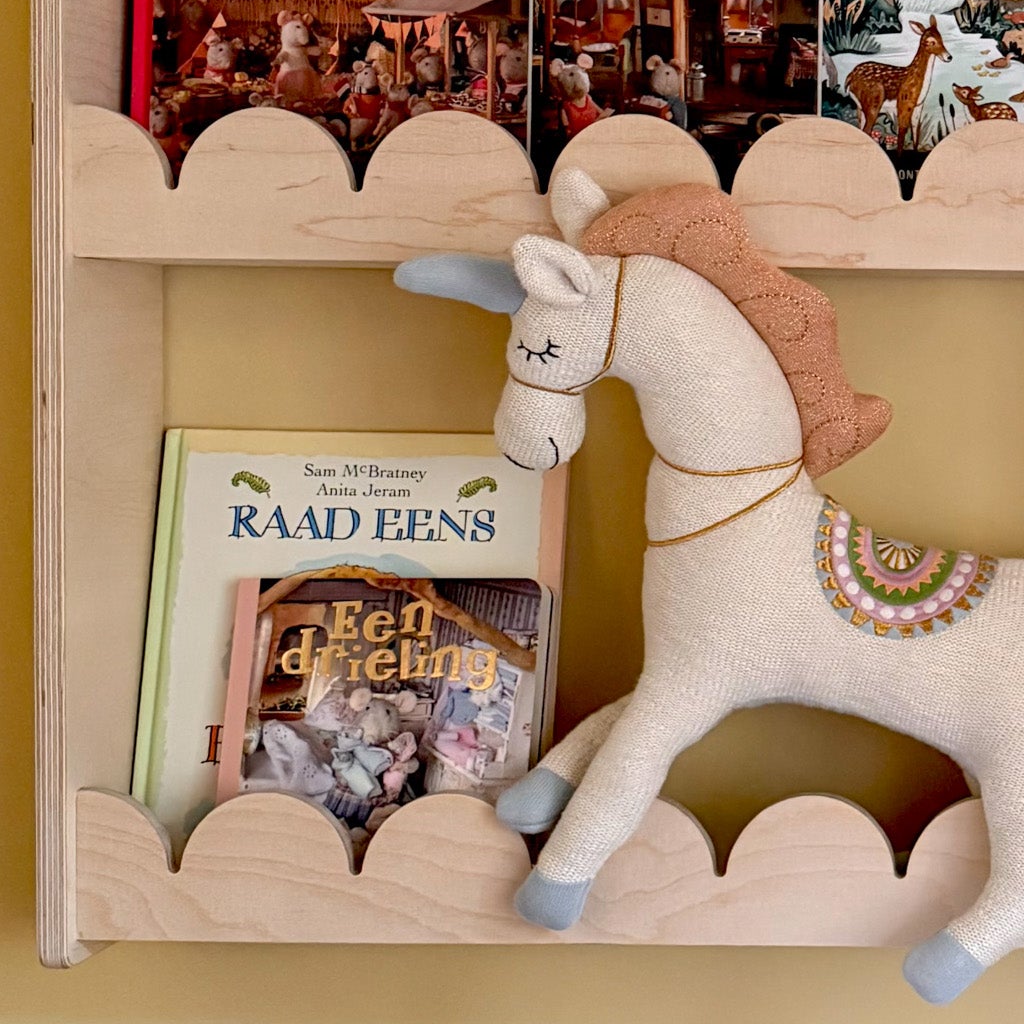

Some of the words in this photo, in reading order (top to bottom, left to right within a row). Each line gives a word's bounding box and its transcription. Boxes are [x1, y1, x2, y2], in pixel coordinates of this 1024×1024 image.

[303, 463, 336, 478] Sam
[342, 463, 428, 483] McBratney
[316, 483, 358, 497] Anita
[362, 484, 411, 498] Jeram
[228, 504, 361, 543] RAAD
[371, 507, 497, 543] EENS
[329, 598, 435, 643] Een
[281, 627, 499, 691] drieling
